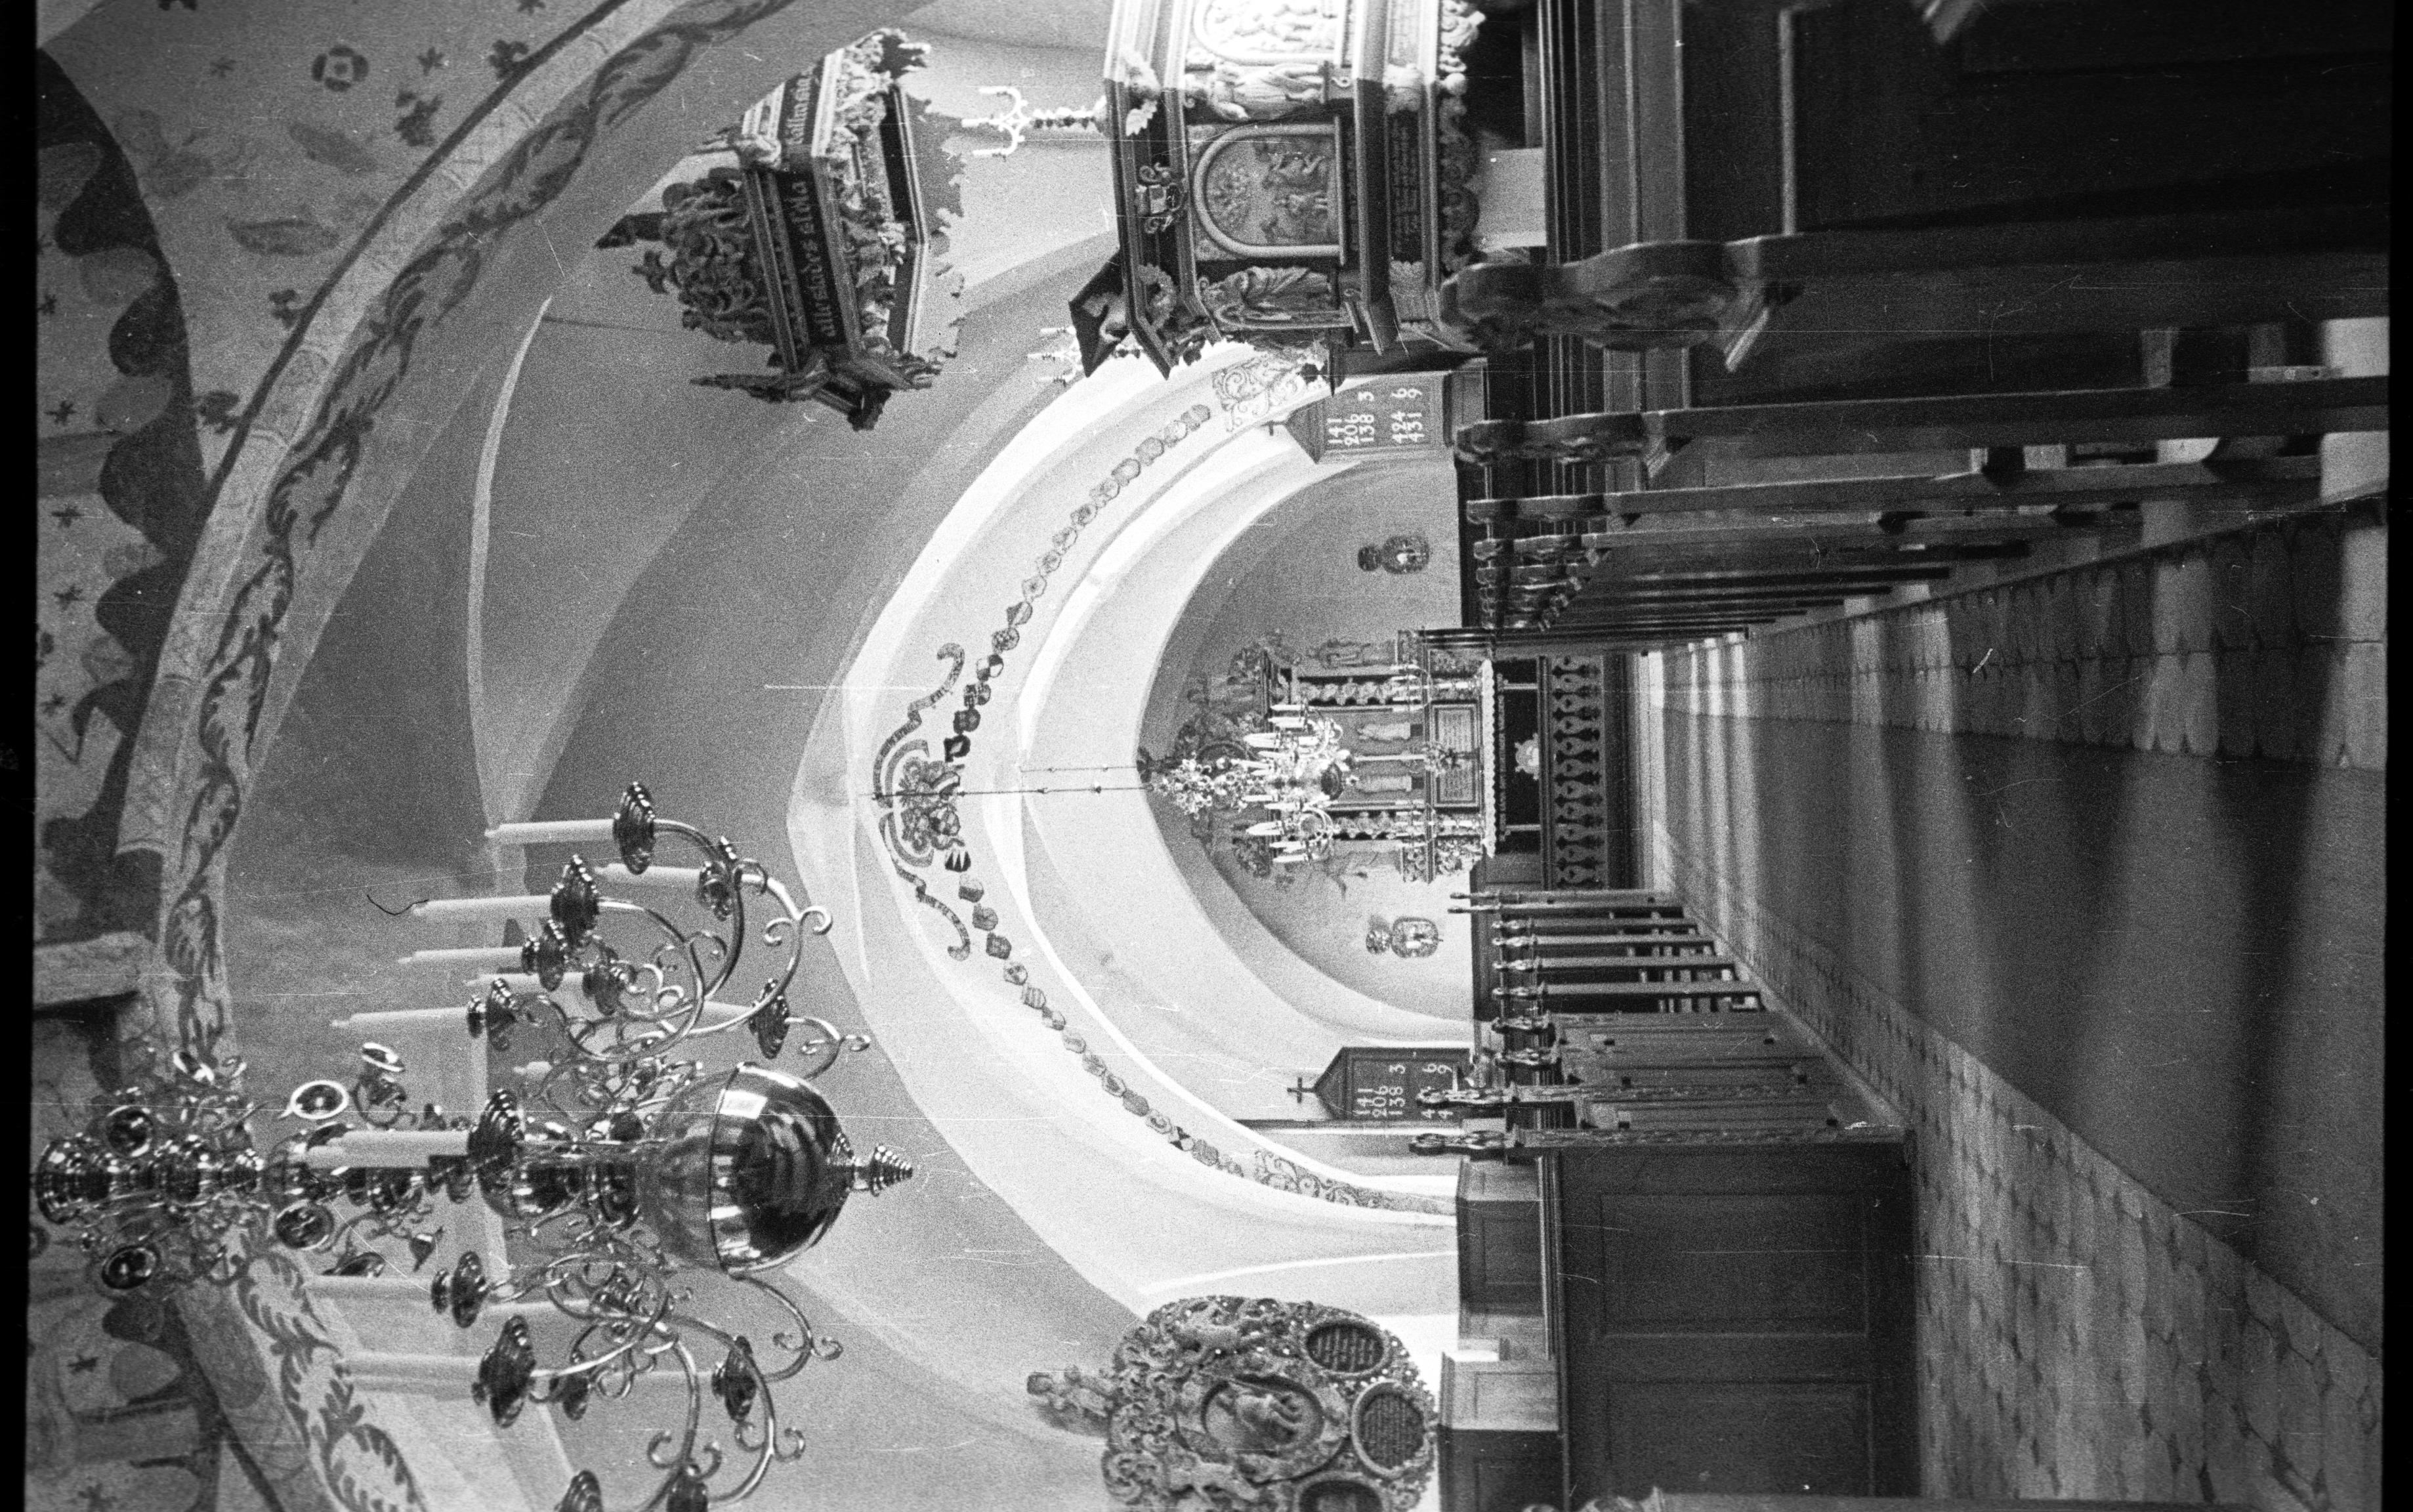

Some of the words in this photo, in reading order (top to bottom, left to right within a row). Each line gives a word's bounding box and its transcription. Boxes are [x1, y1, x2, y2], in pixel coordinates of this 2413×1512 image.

[1358, 391, 1374, 401] 3
[1390, 388, 1407, 398] 6
[1408, 388, 1422, 398] 9
[1327, 417, 1344, 444] 141
[1344, 414, 1360, 446] 206
[1359, 414, 1374, 442] 138
[1391, 411, 1408, 444] 424
[1408, 412, 1424, 442] 431
[1389, 1064, 1406, 1074] 3
[1422, 1063, 1437, 1073] 6
[1437, 1064, 1452, 1074] 9
[1353, 1088, 1374, 1115] 141
[1372, 1085, 1388, 1118] 206
[1389, 1086, 1405, 1115] 138
